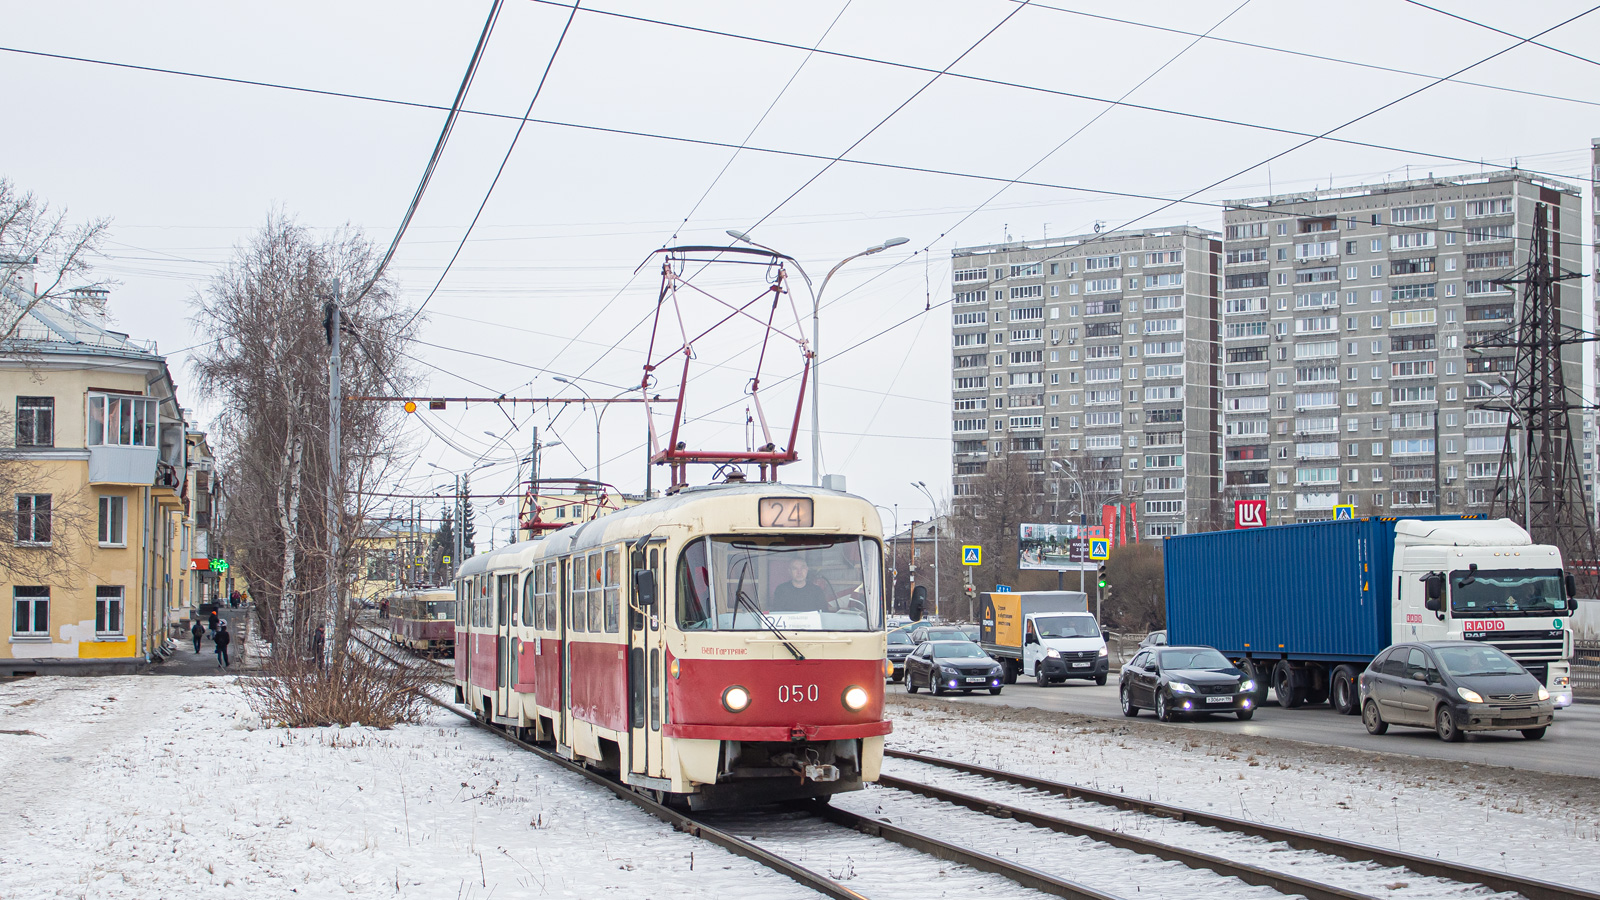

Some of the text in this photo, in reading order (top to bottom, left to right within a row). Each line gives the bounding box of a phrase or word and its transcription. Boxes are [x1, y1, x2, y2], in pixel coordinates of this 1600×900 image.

[771, 502, 801, 527] 24
[1239, 503, 1263, 526] LUK
[1465, 621, 1504, 630] RADO
[778, 684, 819, 703] 050
